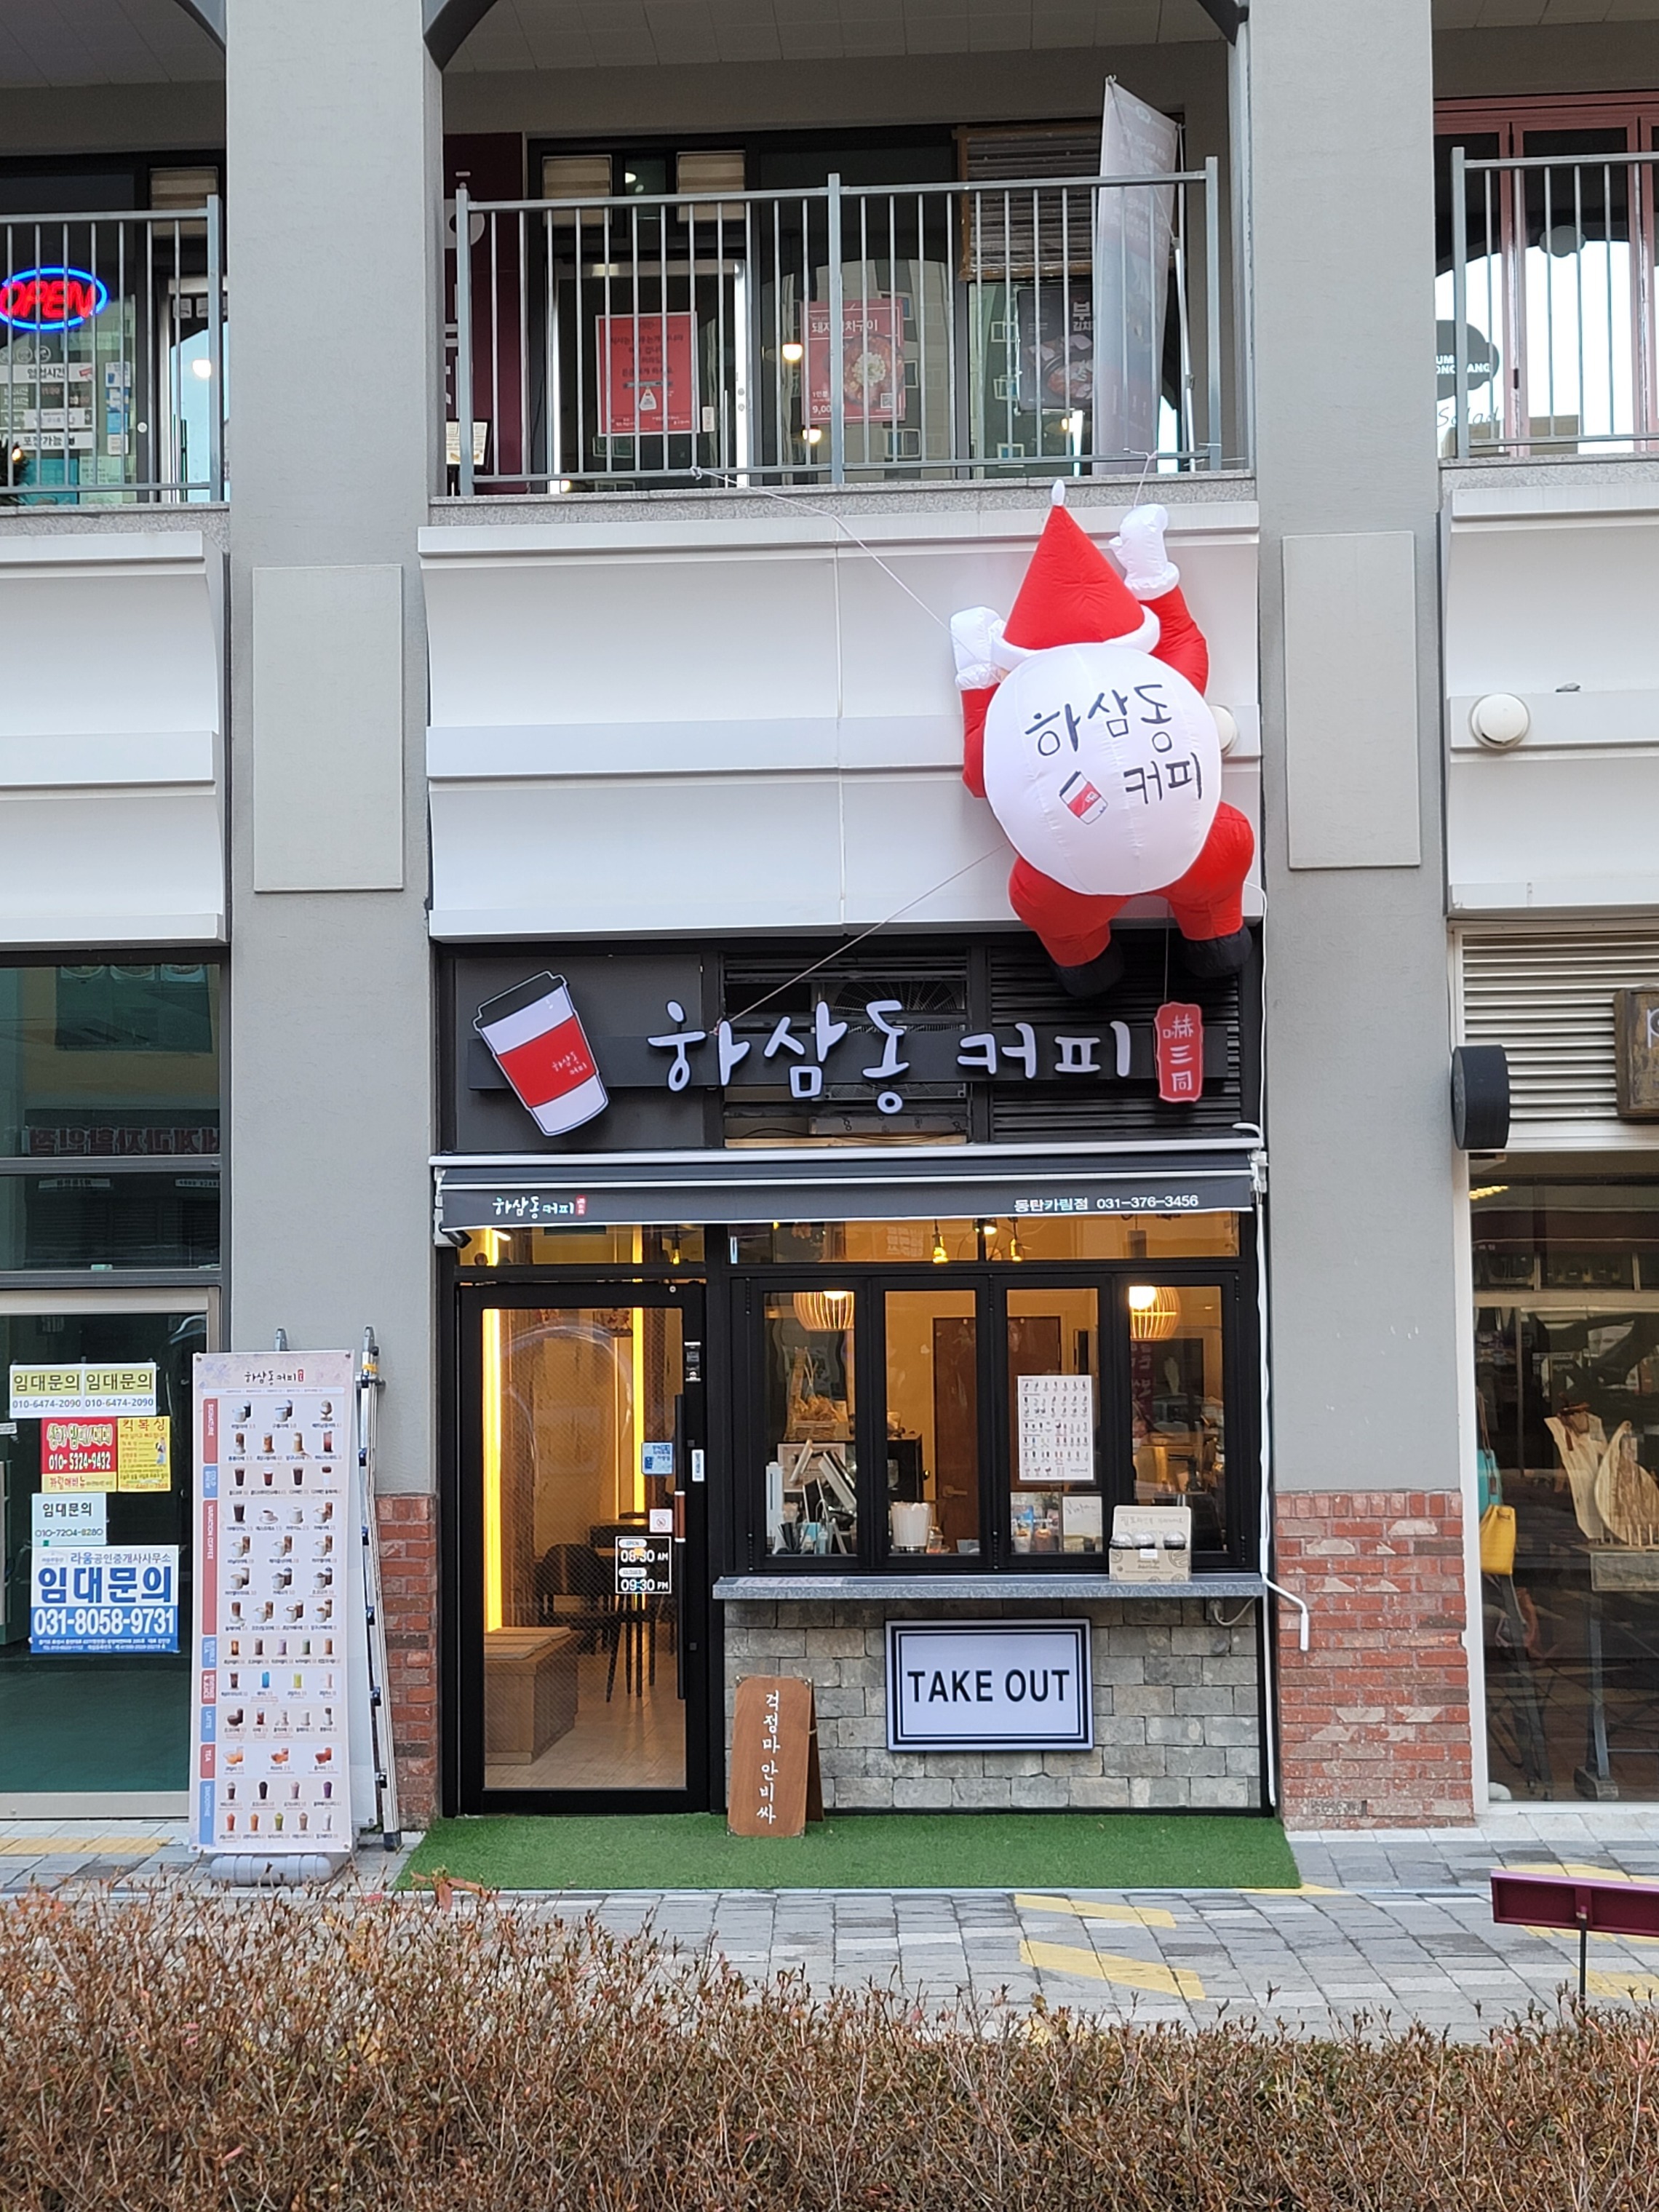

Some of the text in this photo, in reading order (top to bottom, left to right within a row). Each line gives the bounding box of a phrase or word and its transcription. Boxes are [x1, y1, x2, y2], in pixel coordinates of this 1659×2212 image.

[0, 279, 95, 319] OPEN
[1024, 683, 1173, 757] 하삼동
[1123, 752, 1203, 805] 커피
[646, 999, 1131, 1115] 하삼동 커피
[491, 1195, 540, 1220] 하삼동
[543, 1201, 575, 1215] 커피
[1097, 1194, 1199, 1209] 031-376-3456
[13, 1372, 153, 1392] 임대문의 임대문의
[12, 1397, 154, 1409] 010-6474-2090 010-6474-2090
[42, 1502, 92, 1518] 임대문의
[71, 1551, 172, 1565] 라움공인중개사사무소
[657, 1552, 669, 1561] AM
[38, 1566, 172, 1604] 임대문의
[620, 1578, 669, 1591] 09:30 PM
[33, 1607, 174, 1636] 031-8058-9731
[907, 1668, 1071, 1703] TAKE OUT
[757, 1689, 781, 1825] 걱정마 안비싸
